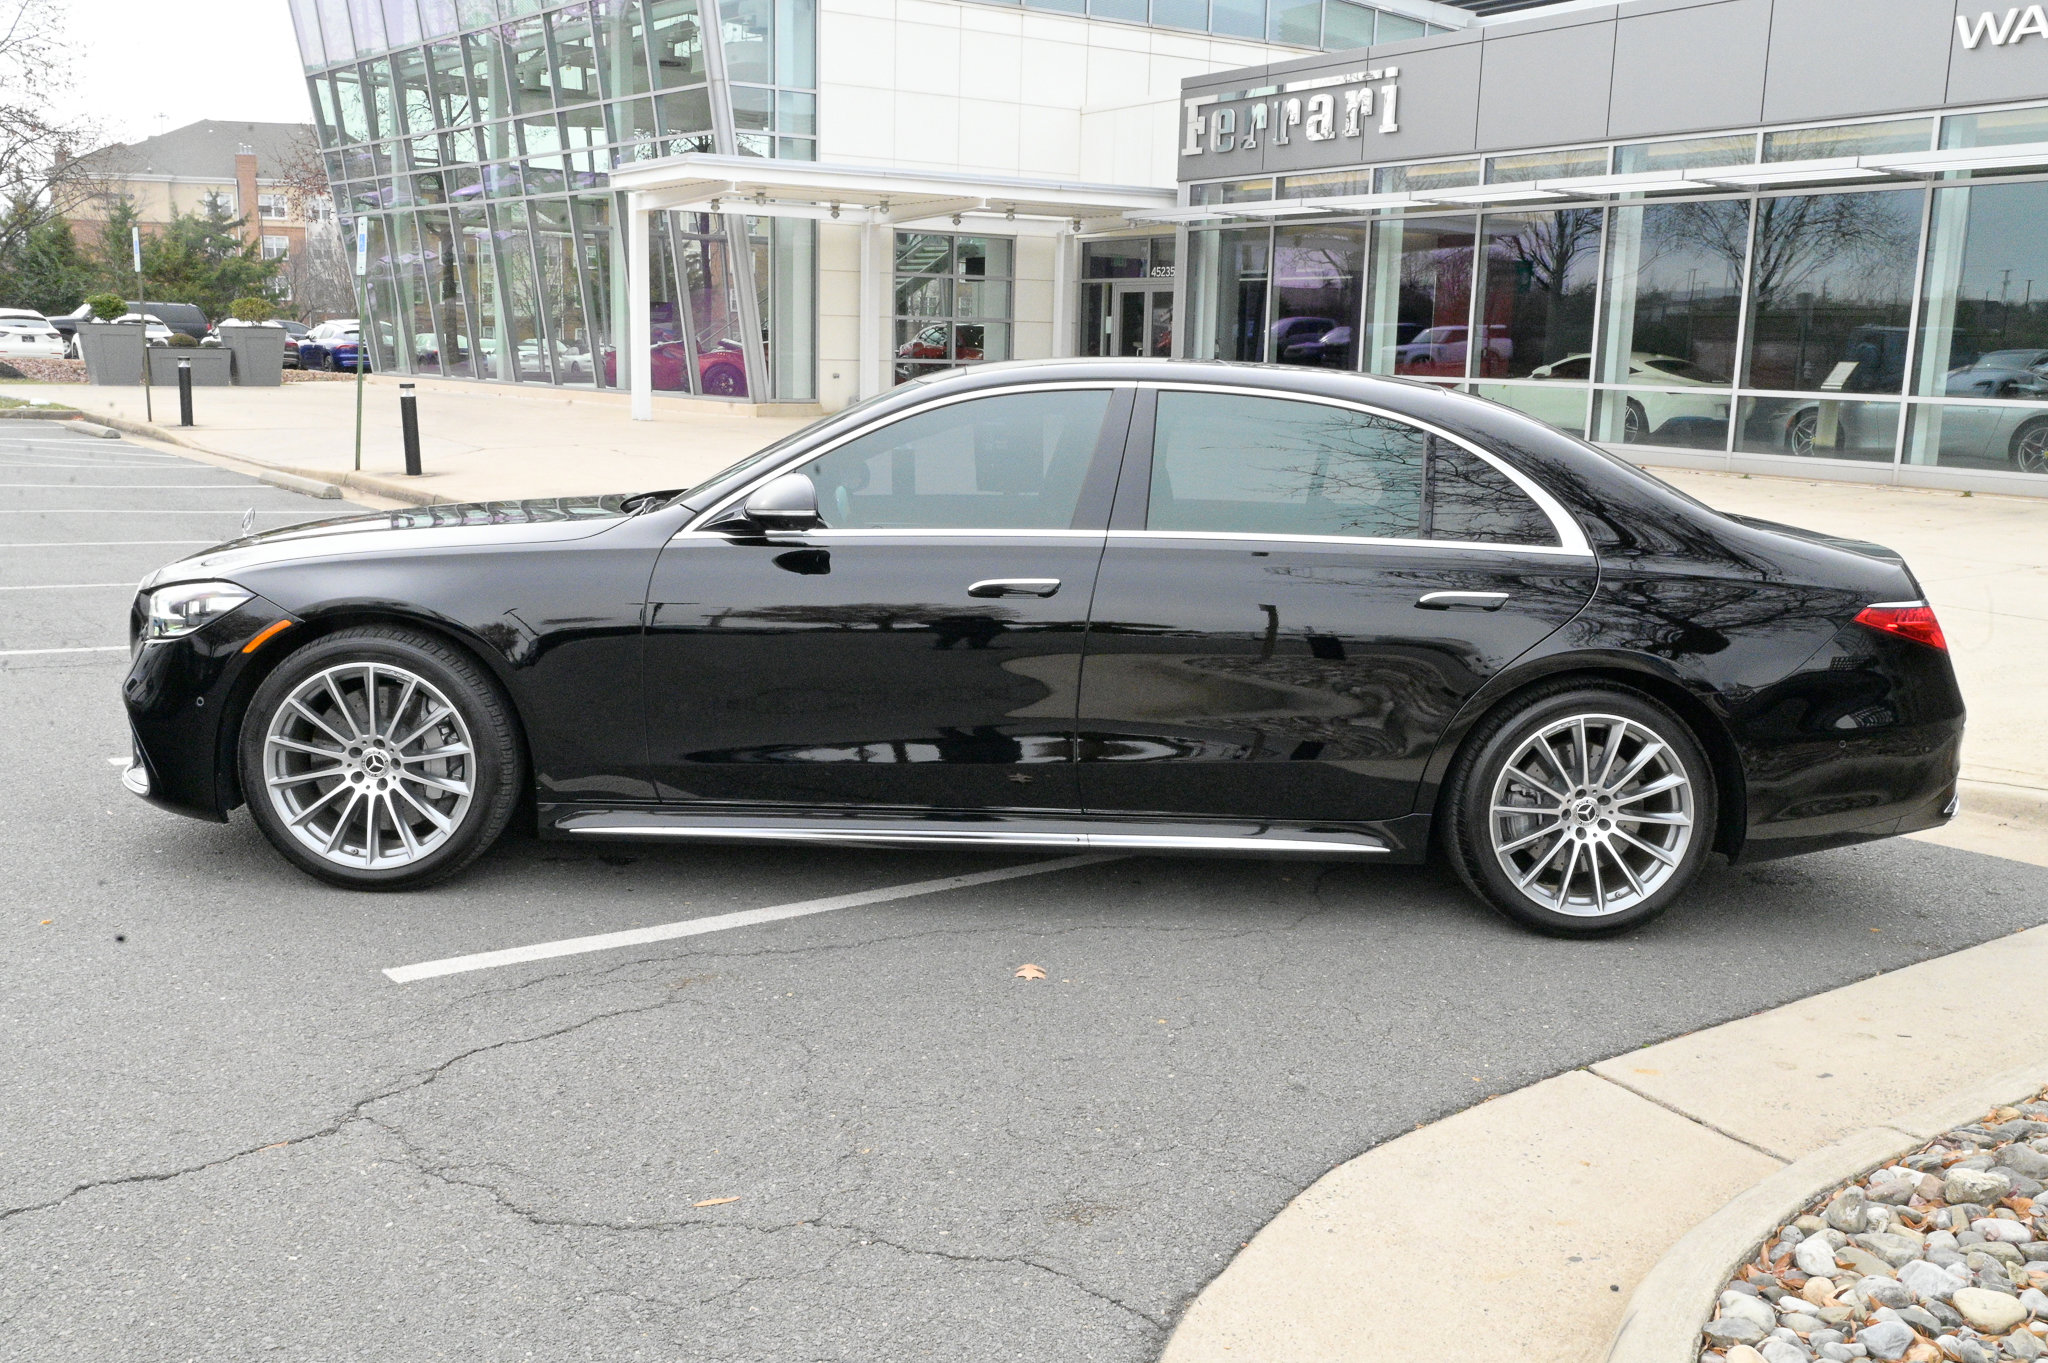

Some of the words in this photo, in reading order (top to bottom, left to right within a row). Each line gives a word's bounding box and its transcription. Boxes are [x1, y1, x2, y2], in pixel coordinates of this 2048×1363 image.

[1956, 5, 2048, 49] WA
[1182, 67, 1399, 155] Ferrari
[1151, 266, 1175, 277] 45235
